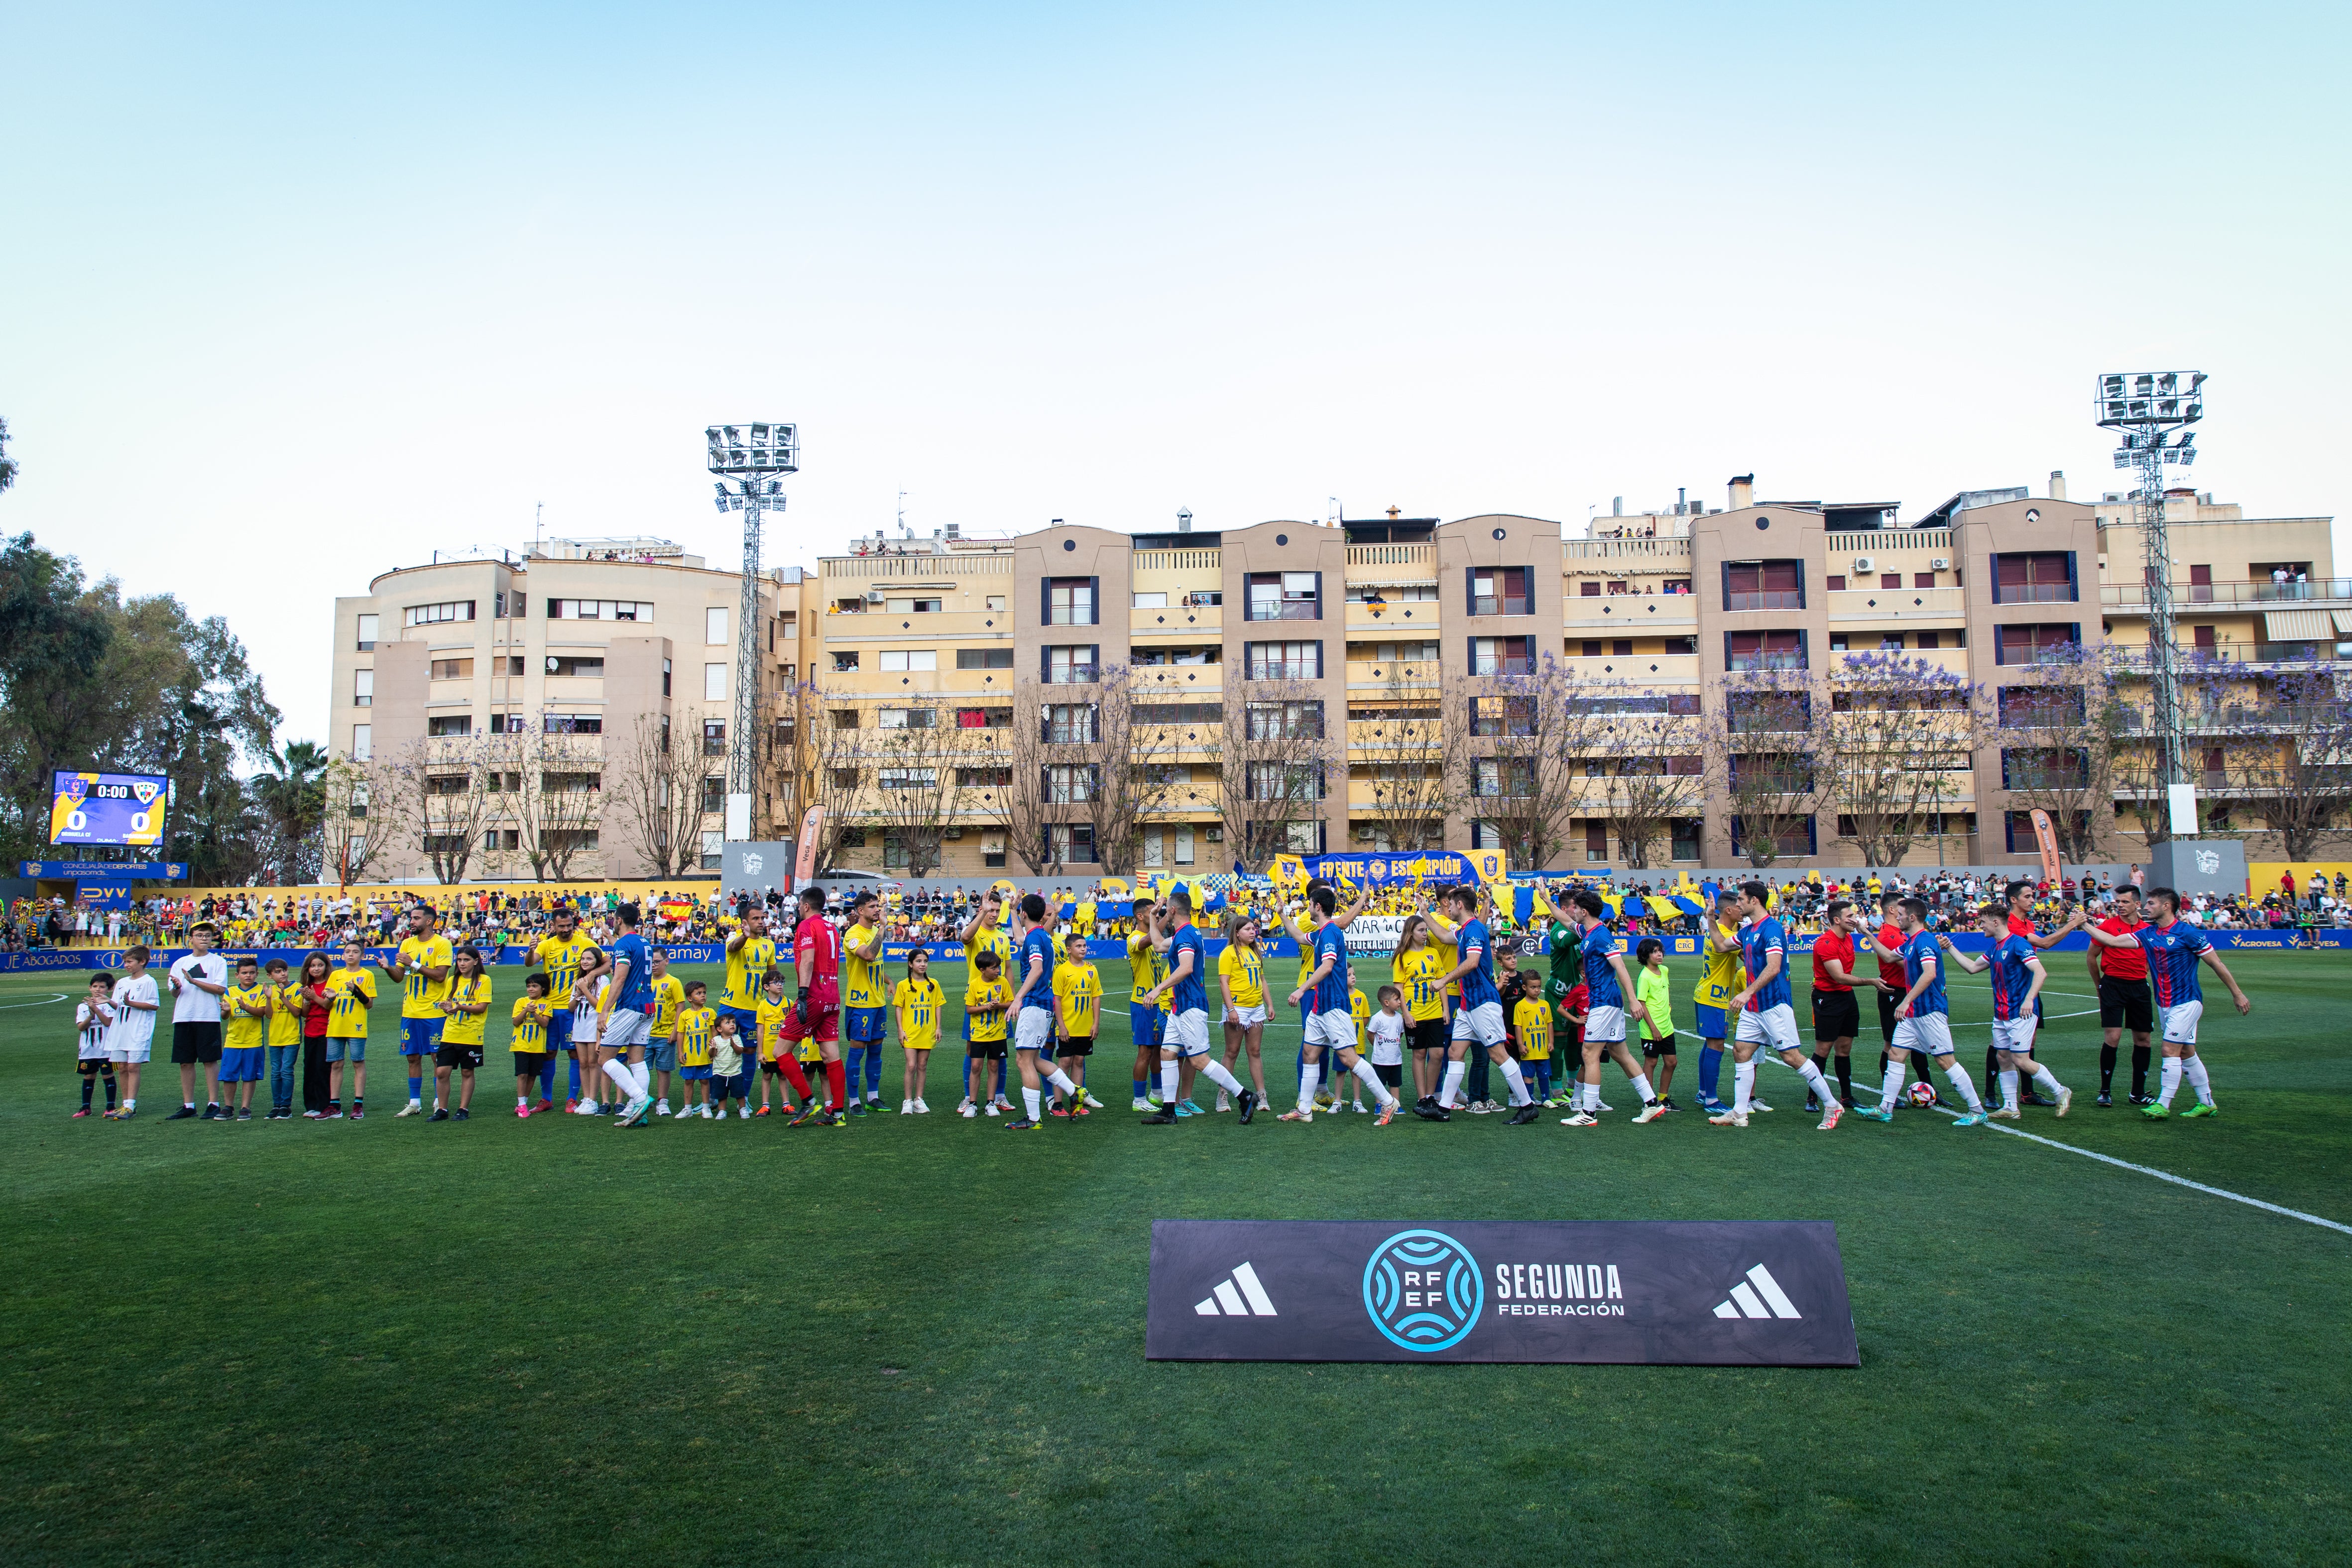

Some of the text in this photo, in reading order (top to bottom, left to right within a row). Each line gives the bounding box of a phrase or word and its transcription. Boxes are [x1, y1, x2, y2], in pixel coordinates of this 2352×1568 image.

[98, 785, 128, 798] 0:00
[67, 811, 87, 831] 0
[131, 812, 150, 832] 0
[1319, 855, 1461, 878] FRENTE ESKRPIÓN
[826, 930, 835, 959] 1
[5, 955, 81, 969] JE ABOGADOS
[644, 946, 653, 975] 5
[668, 949, 711, 962] amay
[850, 989, 868, 1001] DM
[1711, 984, 1729, 999] DM
[862, 1016, 868, 1027] 9
[401, 1028, 410, 1041] 16
[1496, 1264, 1623, 1299] SEGUNDA
[1499, 1302, 1624, 1316] FEDERACIÓN
